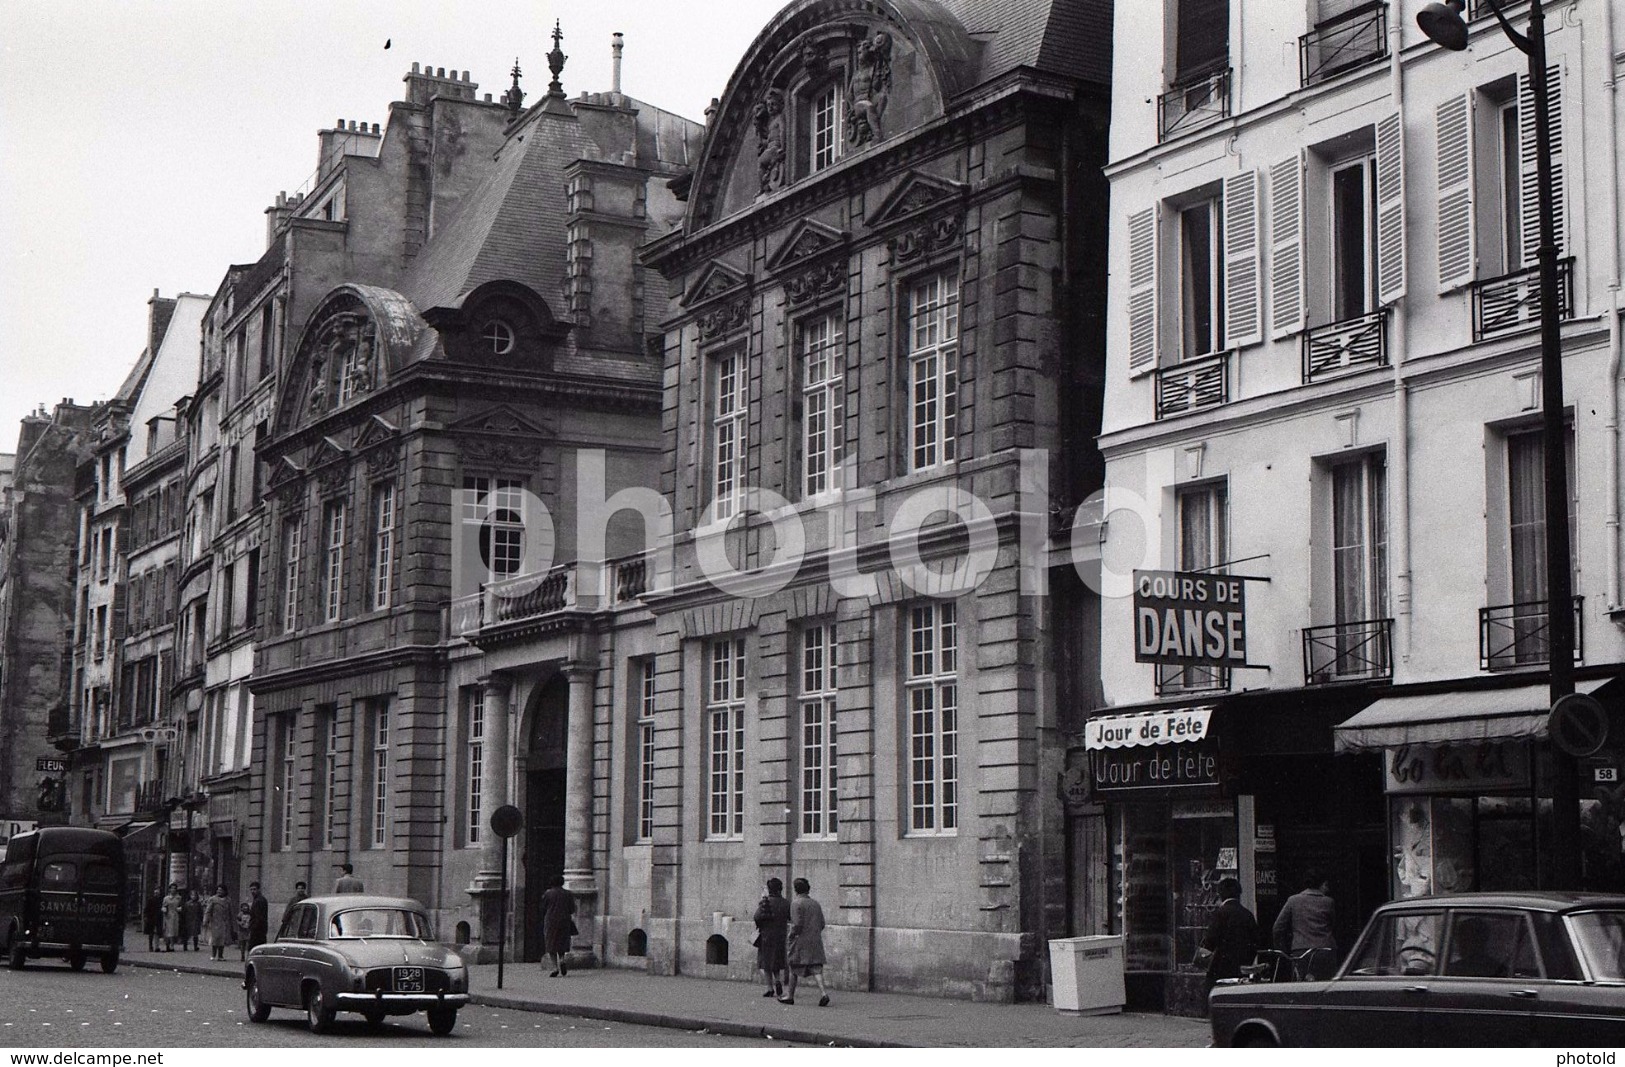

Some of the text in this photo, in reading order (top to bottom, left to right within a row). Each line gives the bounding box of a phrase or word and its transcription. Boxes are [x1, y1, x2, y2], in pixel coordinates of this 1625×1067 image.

[1139, 575, 1240, 603] COURS DE
[1138, 606, 1245, 660] DANSE
[1096, 717, 1203, 743] Jour de Fête
[1096, 753, 1142, 784] Jour
[1149, 749, 1171, 780] de
[1599, 769, 1613, 779] 58
[1256, 869, 1278, 885] DANSE
[39, 900, 78, 913] SANYAS
[398, 968, 421, 978] 1928
[410, 981, 421, 991] 75
